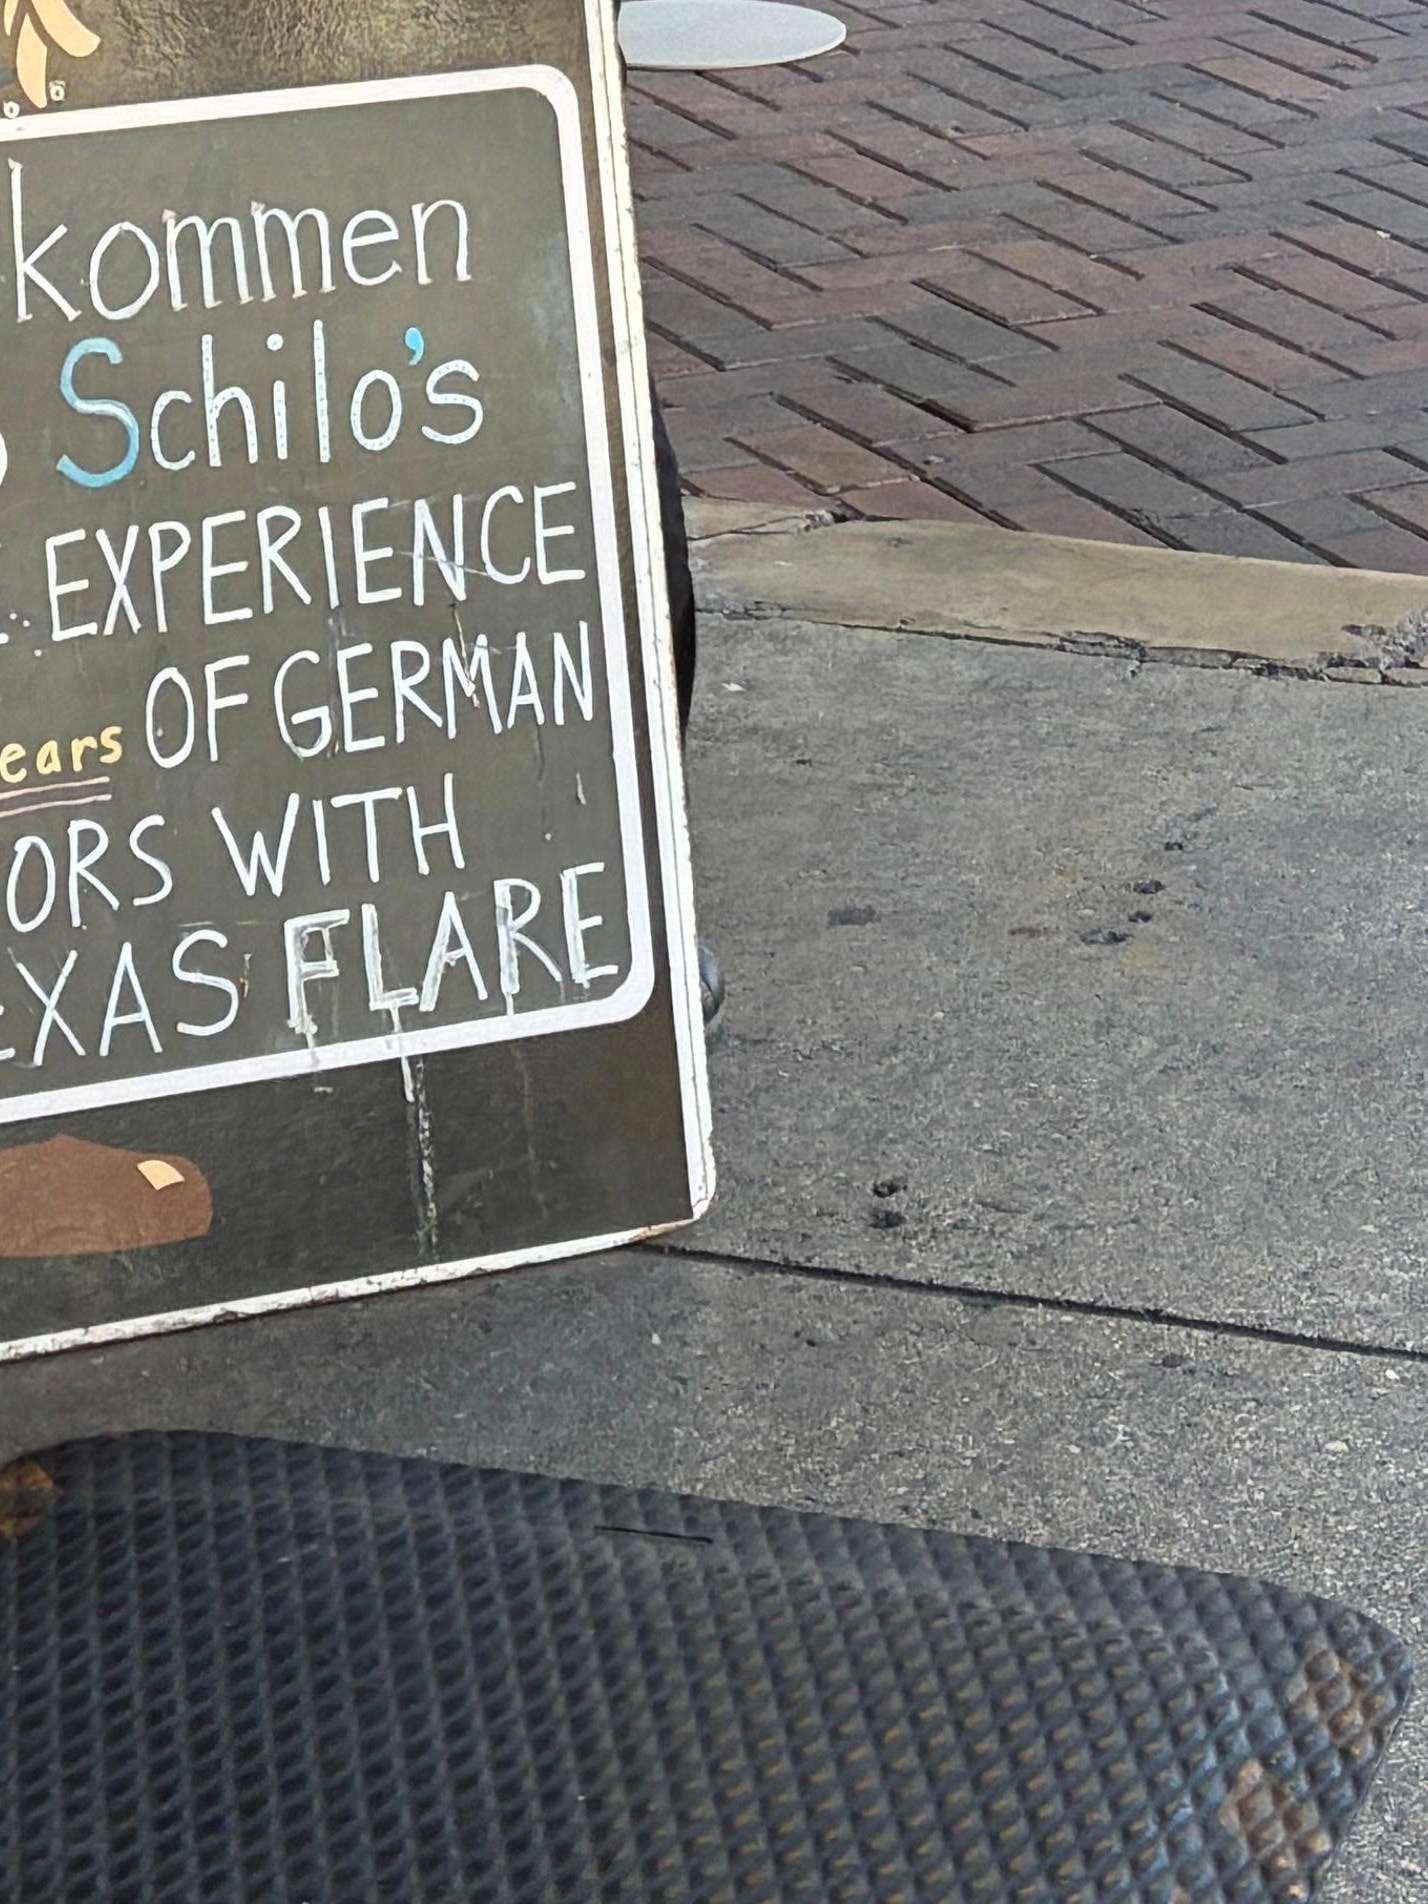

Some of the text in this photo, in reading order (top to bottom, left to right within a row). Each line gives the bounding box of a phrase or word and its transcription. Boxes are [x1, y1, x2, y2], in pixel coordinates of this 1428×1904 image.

[57, 318, 485, 491] Schilo's
[46, 481, 589, 646] EXPERIENCE
[143, 657, 251, 771] OF
[274, 620, 597, 762] GERMAN
[213, 772, 469, 902] WITH
[285, 859, 620, 1034] FLARE
